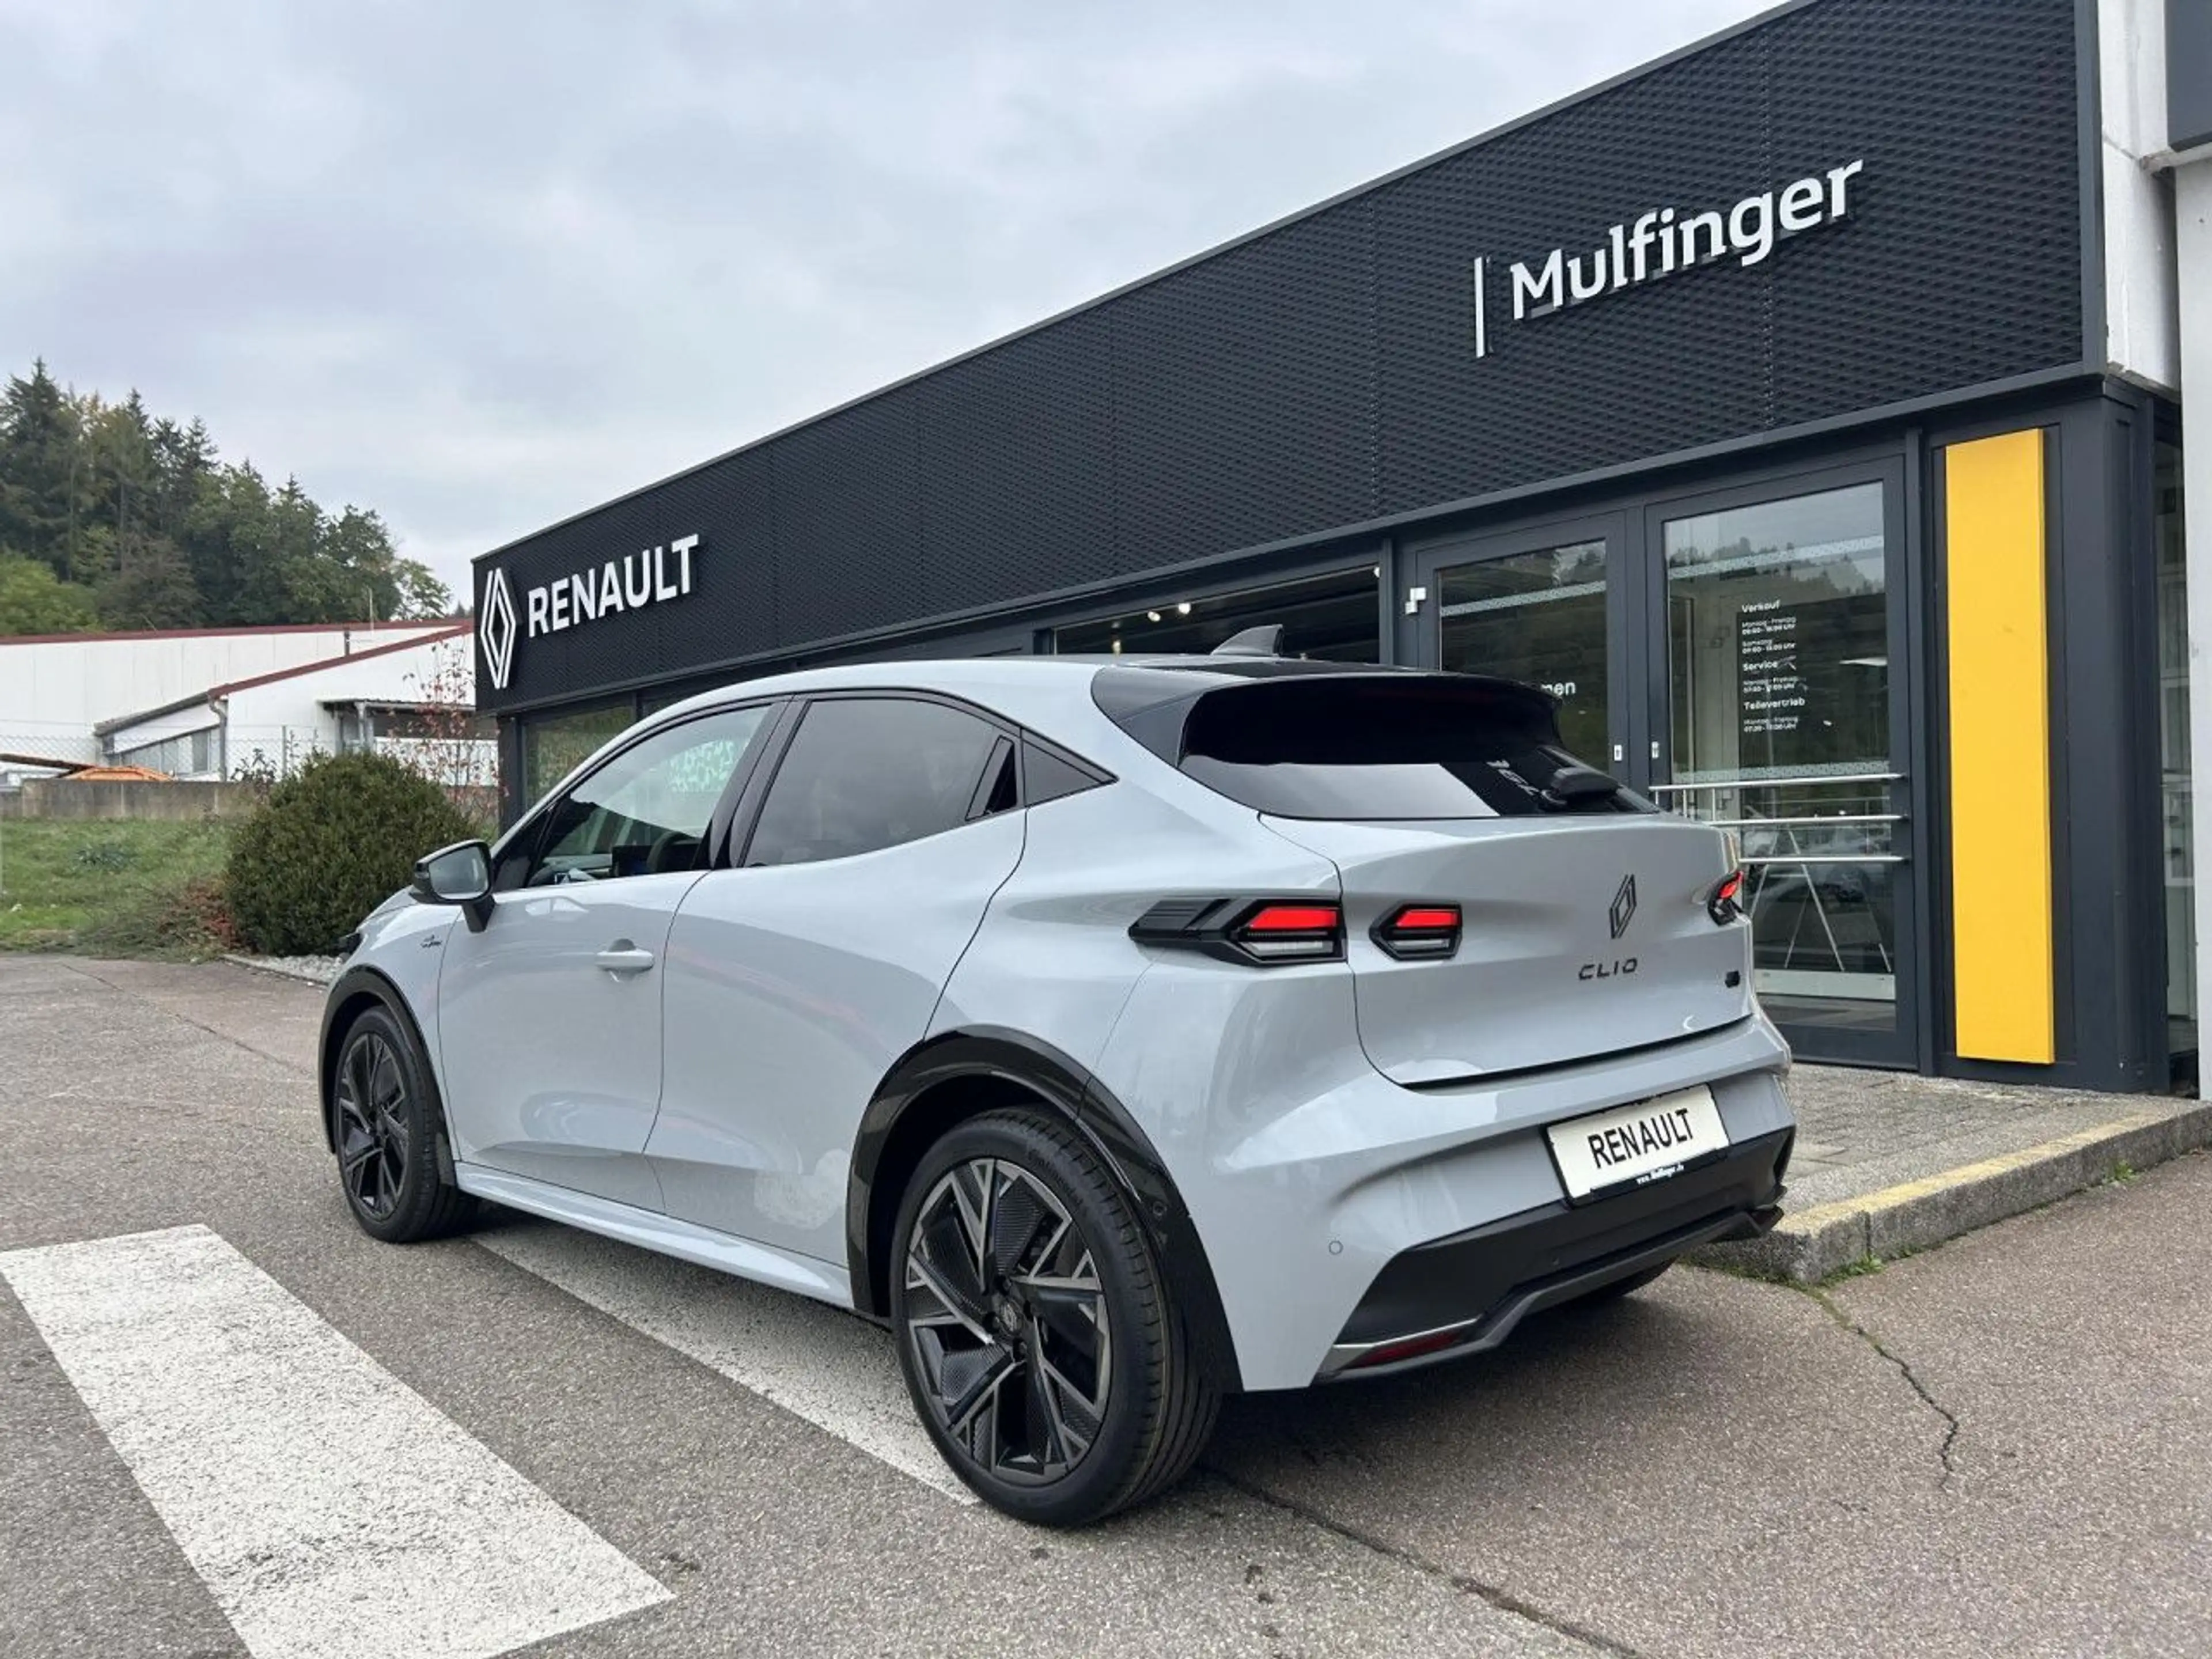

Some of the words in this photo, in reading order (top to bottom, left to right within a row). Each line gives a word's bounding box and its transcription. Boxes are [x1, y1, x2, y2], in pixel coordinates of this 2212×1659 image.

[1510, 159, 1863, 320] Mulfinger
[528, 533, 698, 638] RENAULT
[1743, 660, 1778, 672] Service
[1579, 958, 1638, 980] CLIO
[1588, 1108, 1694, 1169] RENAULT
